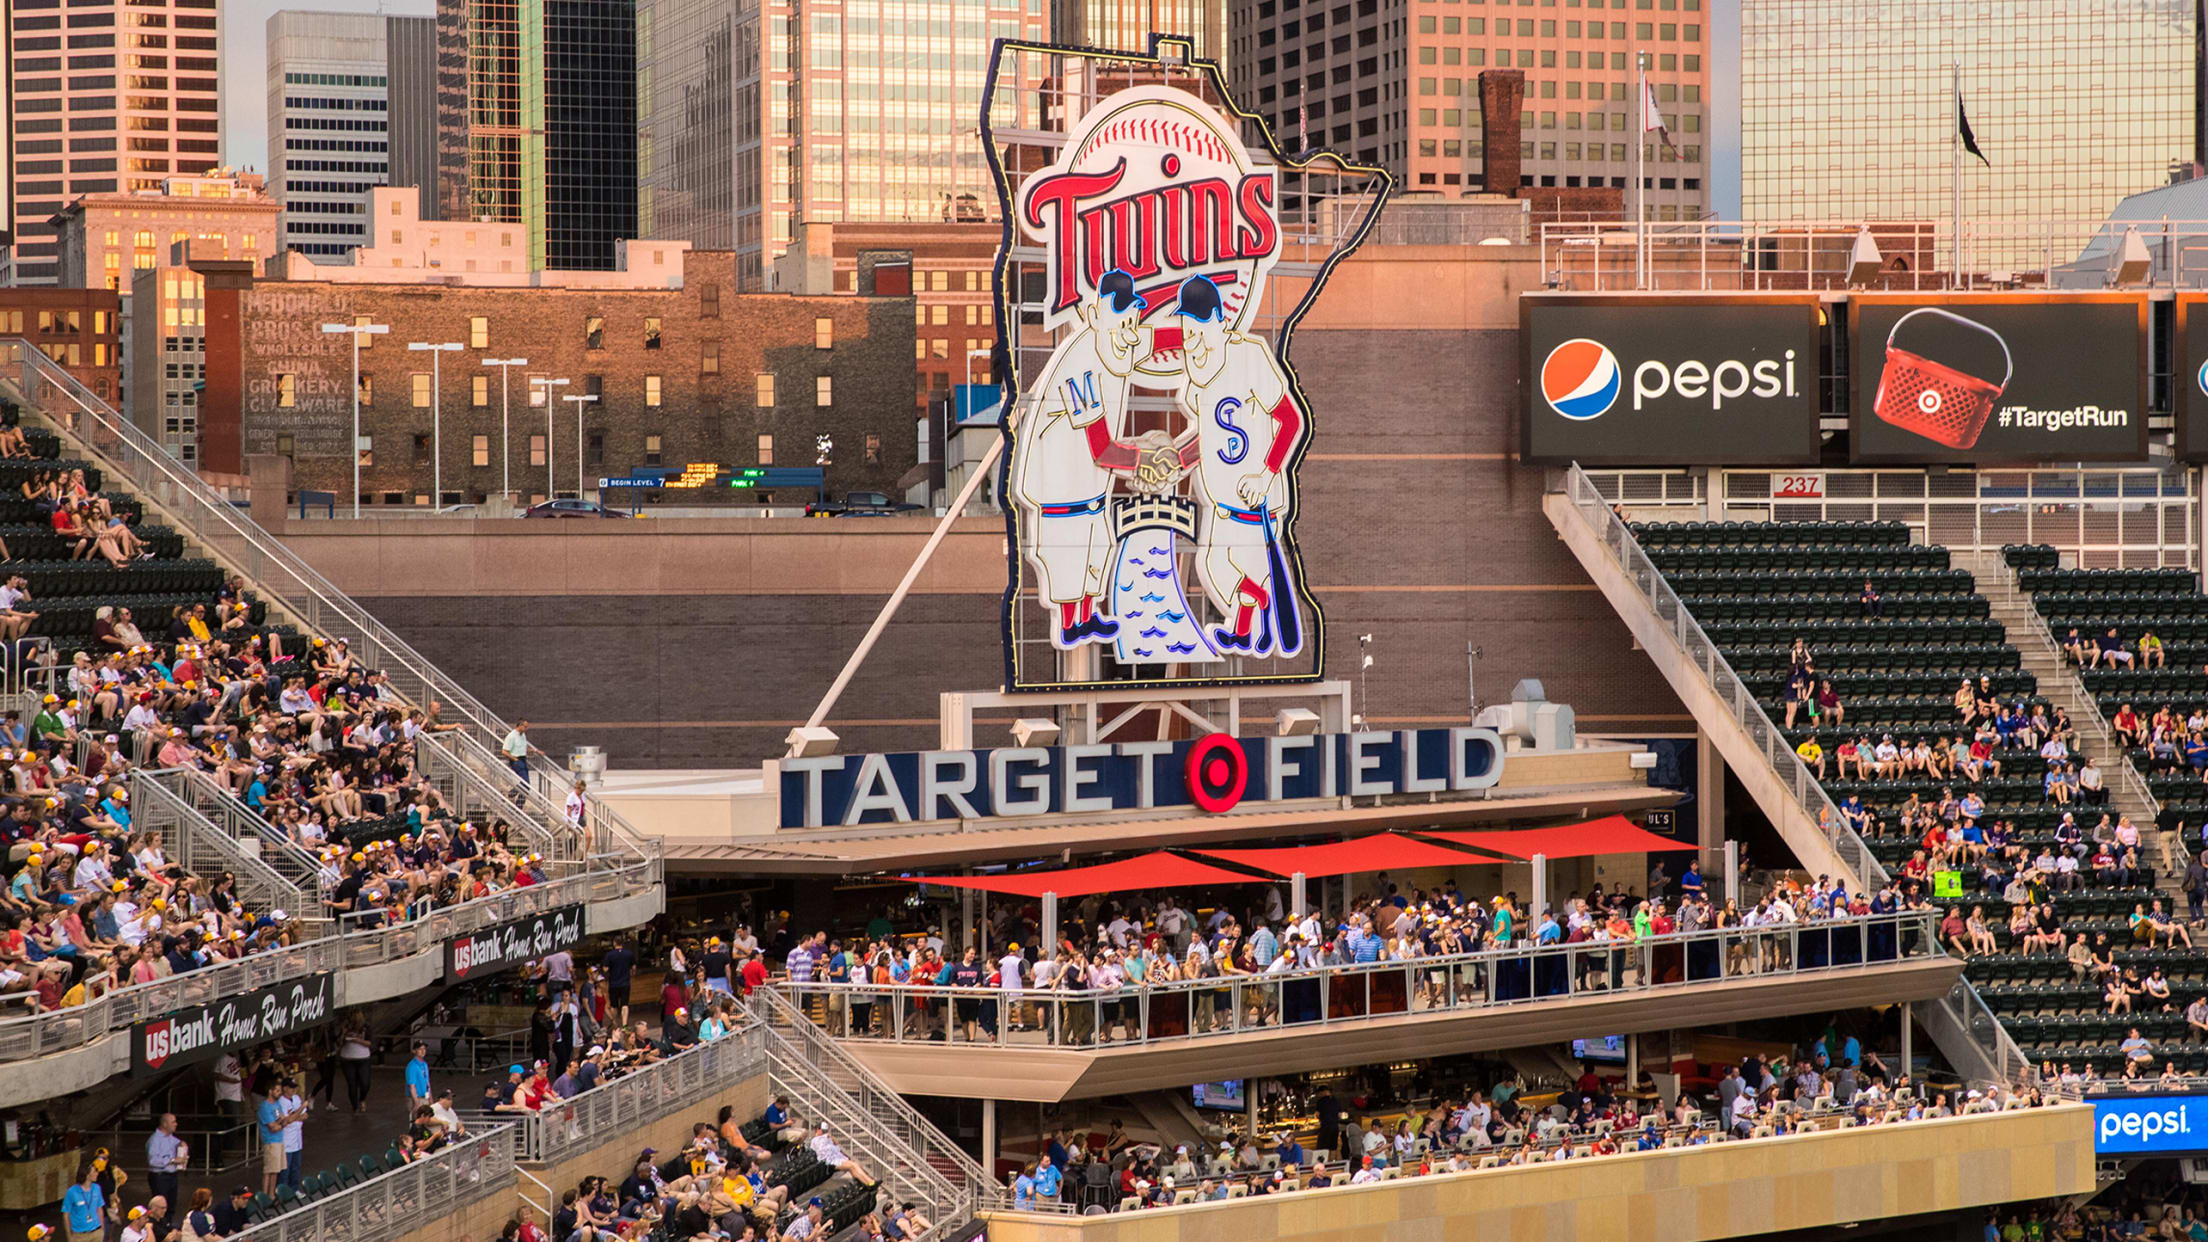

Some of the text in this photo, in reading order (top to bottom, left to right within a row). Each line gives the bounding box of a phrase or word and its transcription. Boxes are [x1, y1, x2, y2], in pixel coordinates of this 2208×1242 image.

[1024, 153, 1277, 316] Twins
[1066, 371, 1100, 416] M
[1633, 349, 1796, 410] pepsi
[1998, 406, 2128, 432] #TargetRun
[658, 478, 666, 487] 7
[1782, 476, 1819, 494] 237
[779, 727, 1505, 829] TARGET FIELD
[1648, 813, 1669, 825] UL'S
[504, 926, 530, 962] Home
[533, 920, 552, 955] Run
[555, 908, 579, 950] Porch
[219, 1003, 257, 1047] Home
[261, 994, 288, 1037] Run
[291, 977, 325, 1029] Porch
[2101, 1104, 2187, 1144] pepsi
